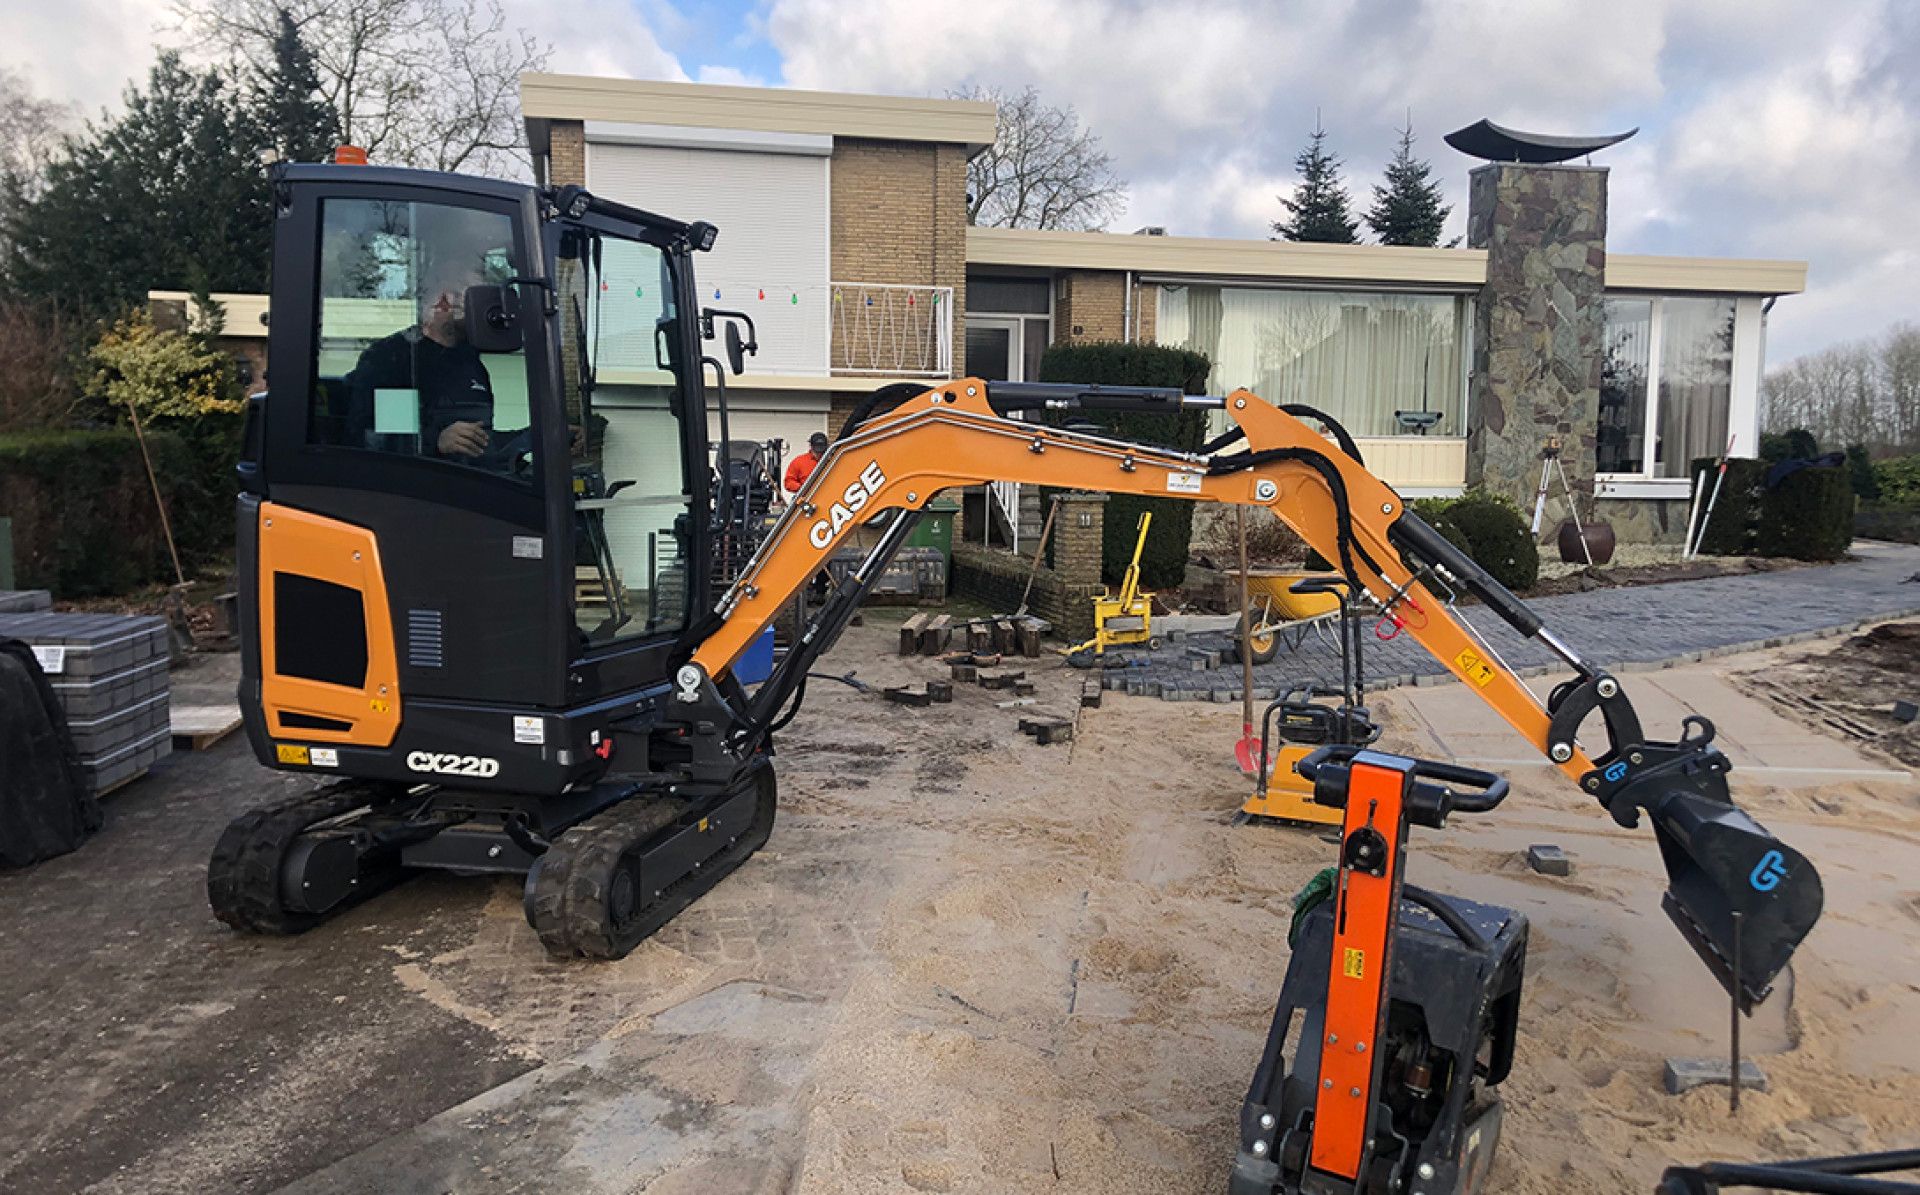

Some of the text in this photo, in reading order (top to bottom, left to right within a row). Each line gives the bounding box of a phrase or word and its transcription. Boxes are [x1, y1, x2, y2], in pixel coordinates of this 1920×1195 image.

[809, 459, 887, 549] CASE
[406, 751, 500, 778] CX22D
[1749, 849, 1787, 891] GP
